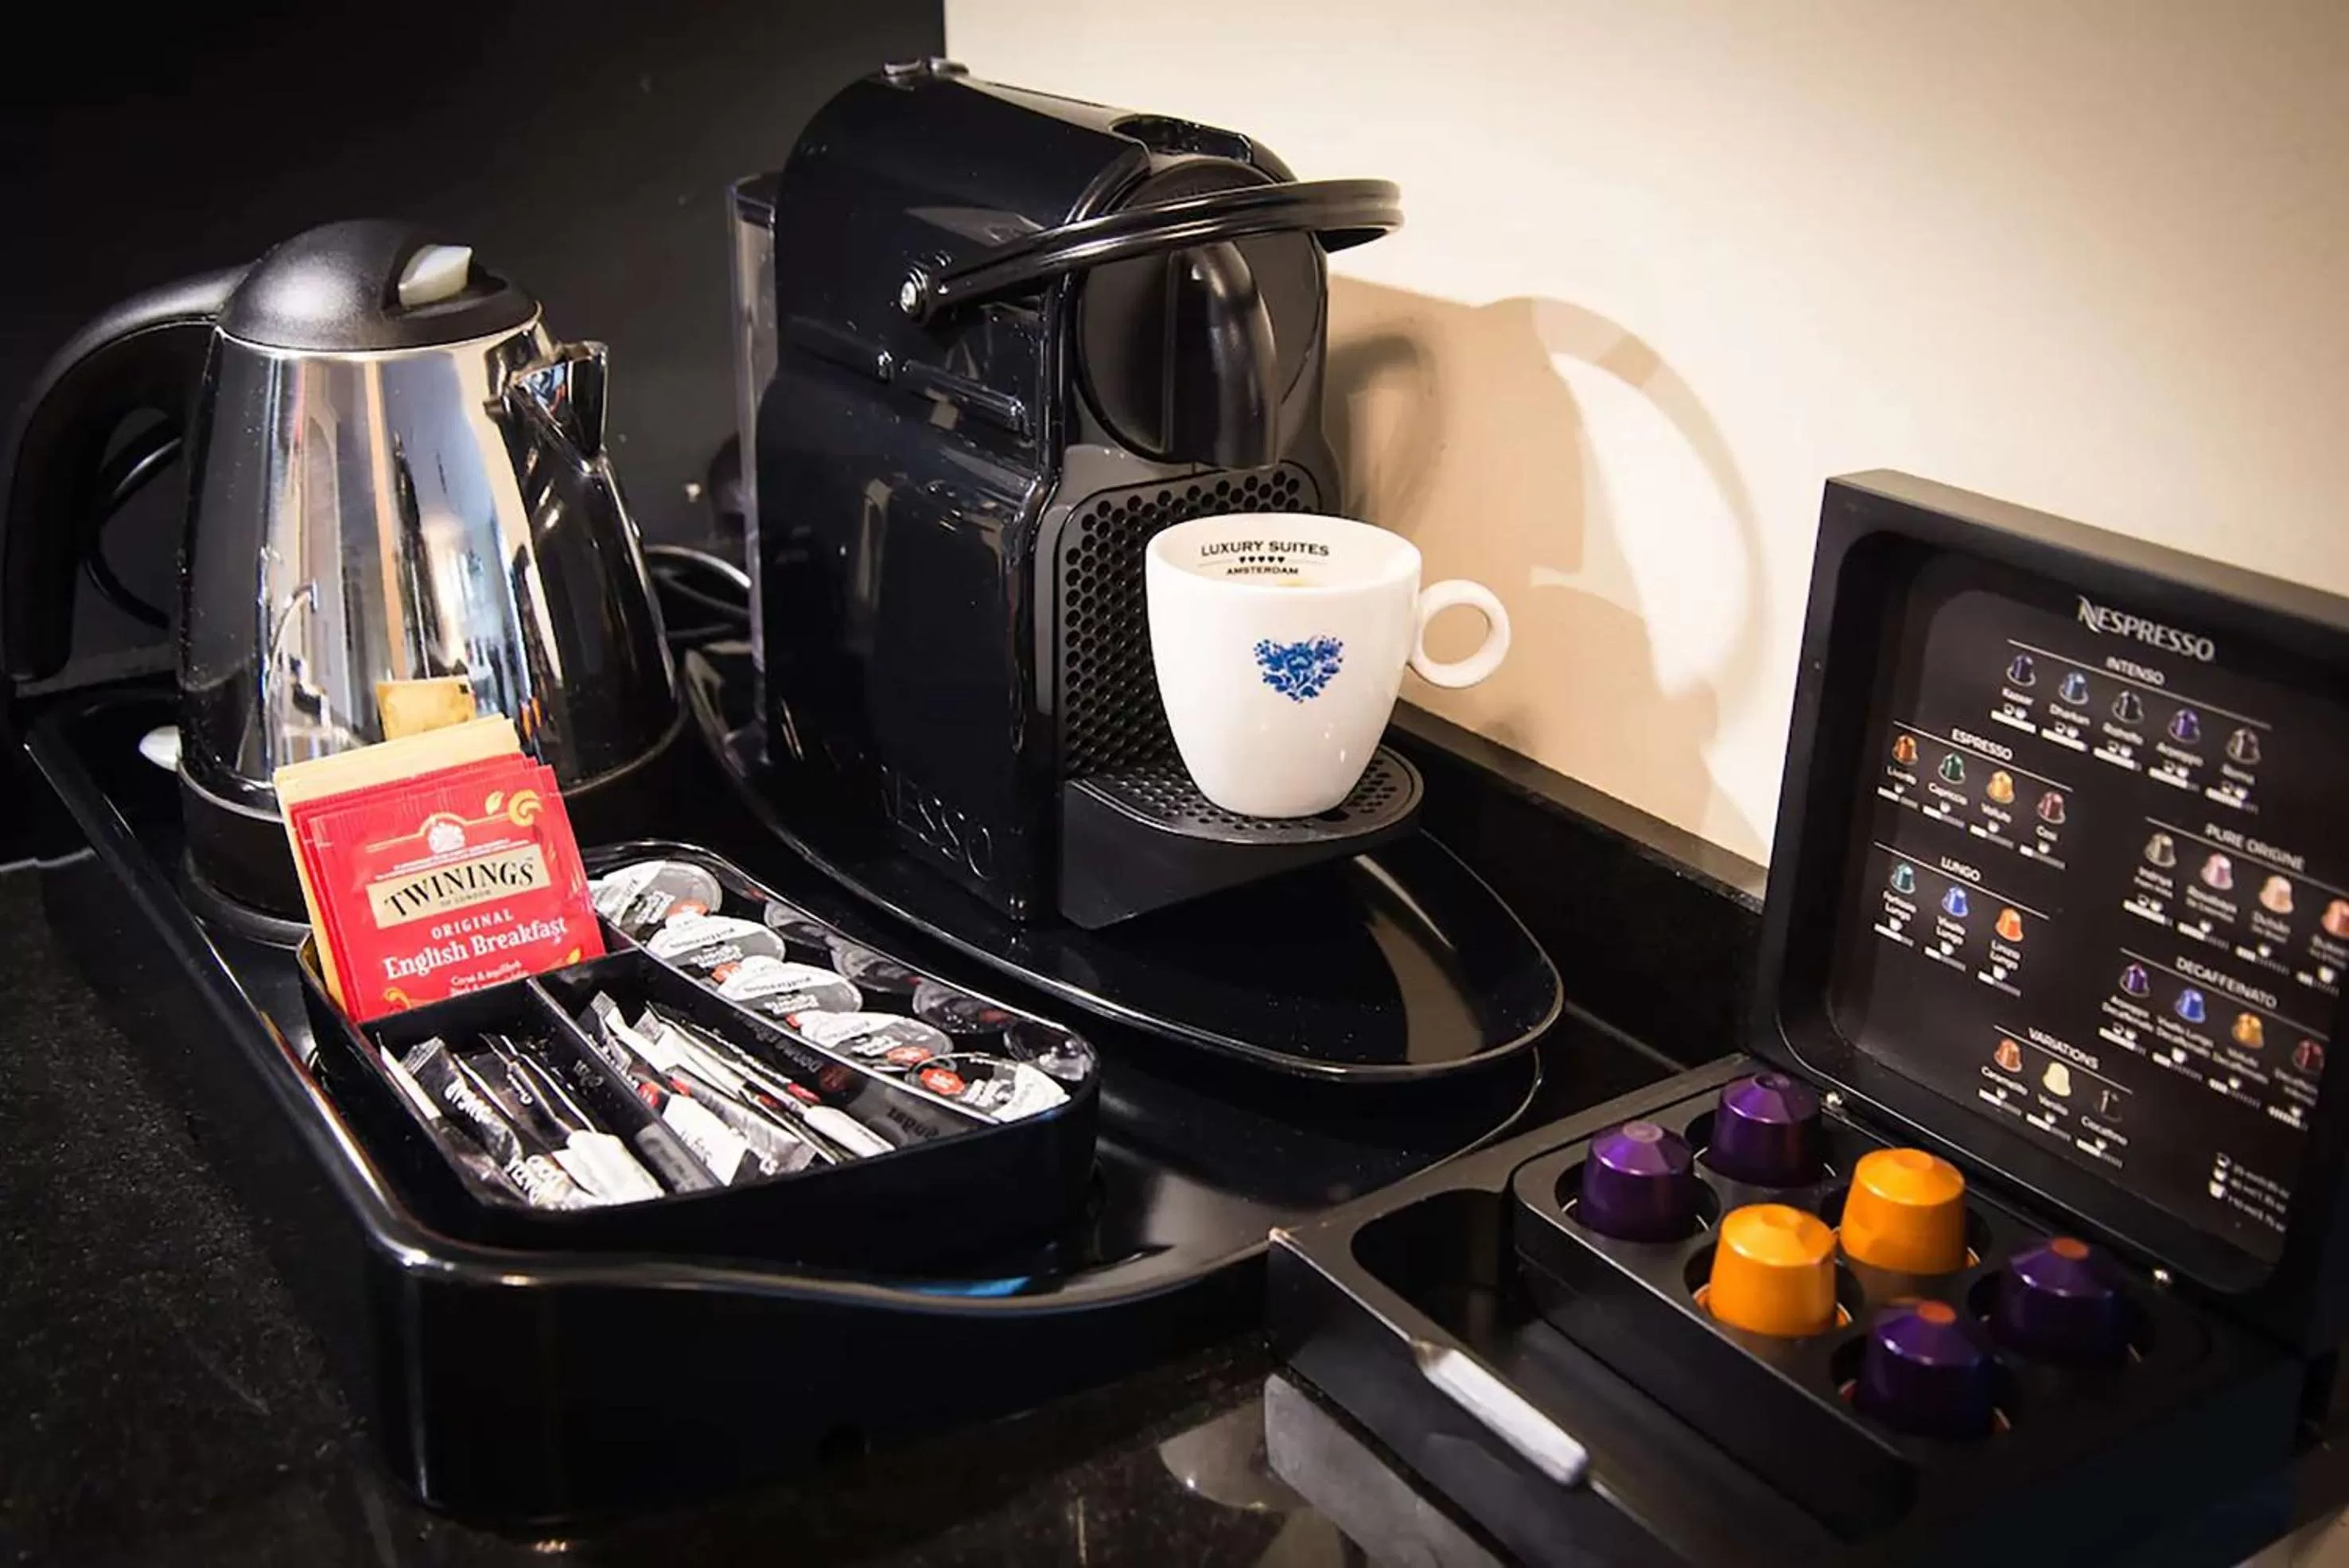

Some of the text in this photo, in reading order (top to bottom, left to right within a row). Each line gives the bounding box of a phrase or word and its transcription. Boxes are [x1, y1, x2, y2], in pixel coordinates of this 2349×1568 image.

[1201, 541, 1329, 557] LUXURY SUITES
[1226, 566, 1299, 575] AMSTERDAM
[2077, 595, 2215, 662] NESPRESSO
[2106, 656, 2165, 686] INTENSO
[1951, 727, 2013, 762] ESPRESSO
[2205, 822, 2305, 873] PURE ORIGINE
[383, 860, 535, 916] TWININGS
[1941, 855, 1981, 882] LUNGO
[431, 909, 515, 940] ORIGINAL
[383, 916, 569, 980] English Breakfast
[2176, 955, 2278, 1010] DECAFFEINATO
[2028, 1027, 2100, 1070] VARIATIONS
